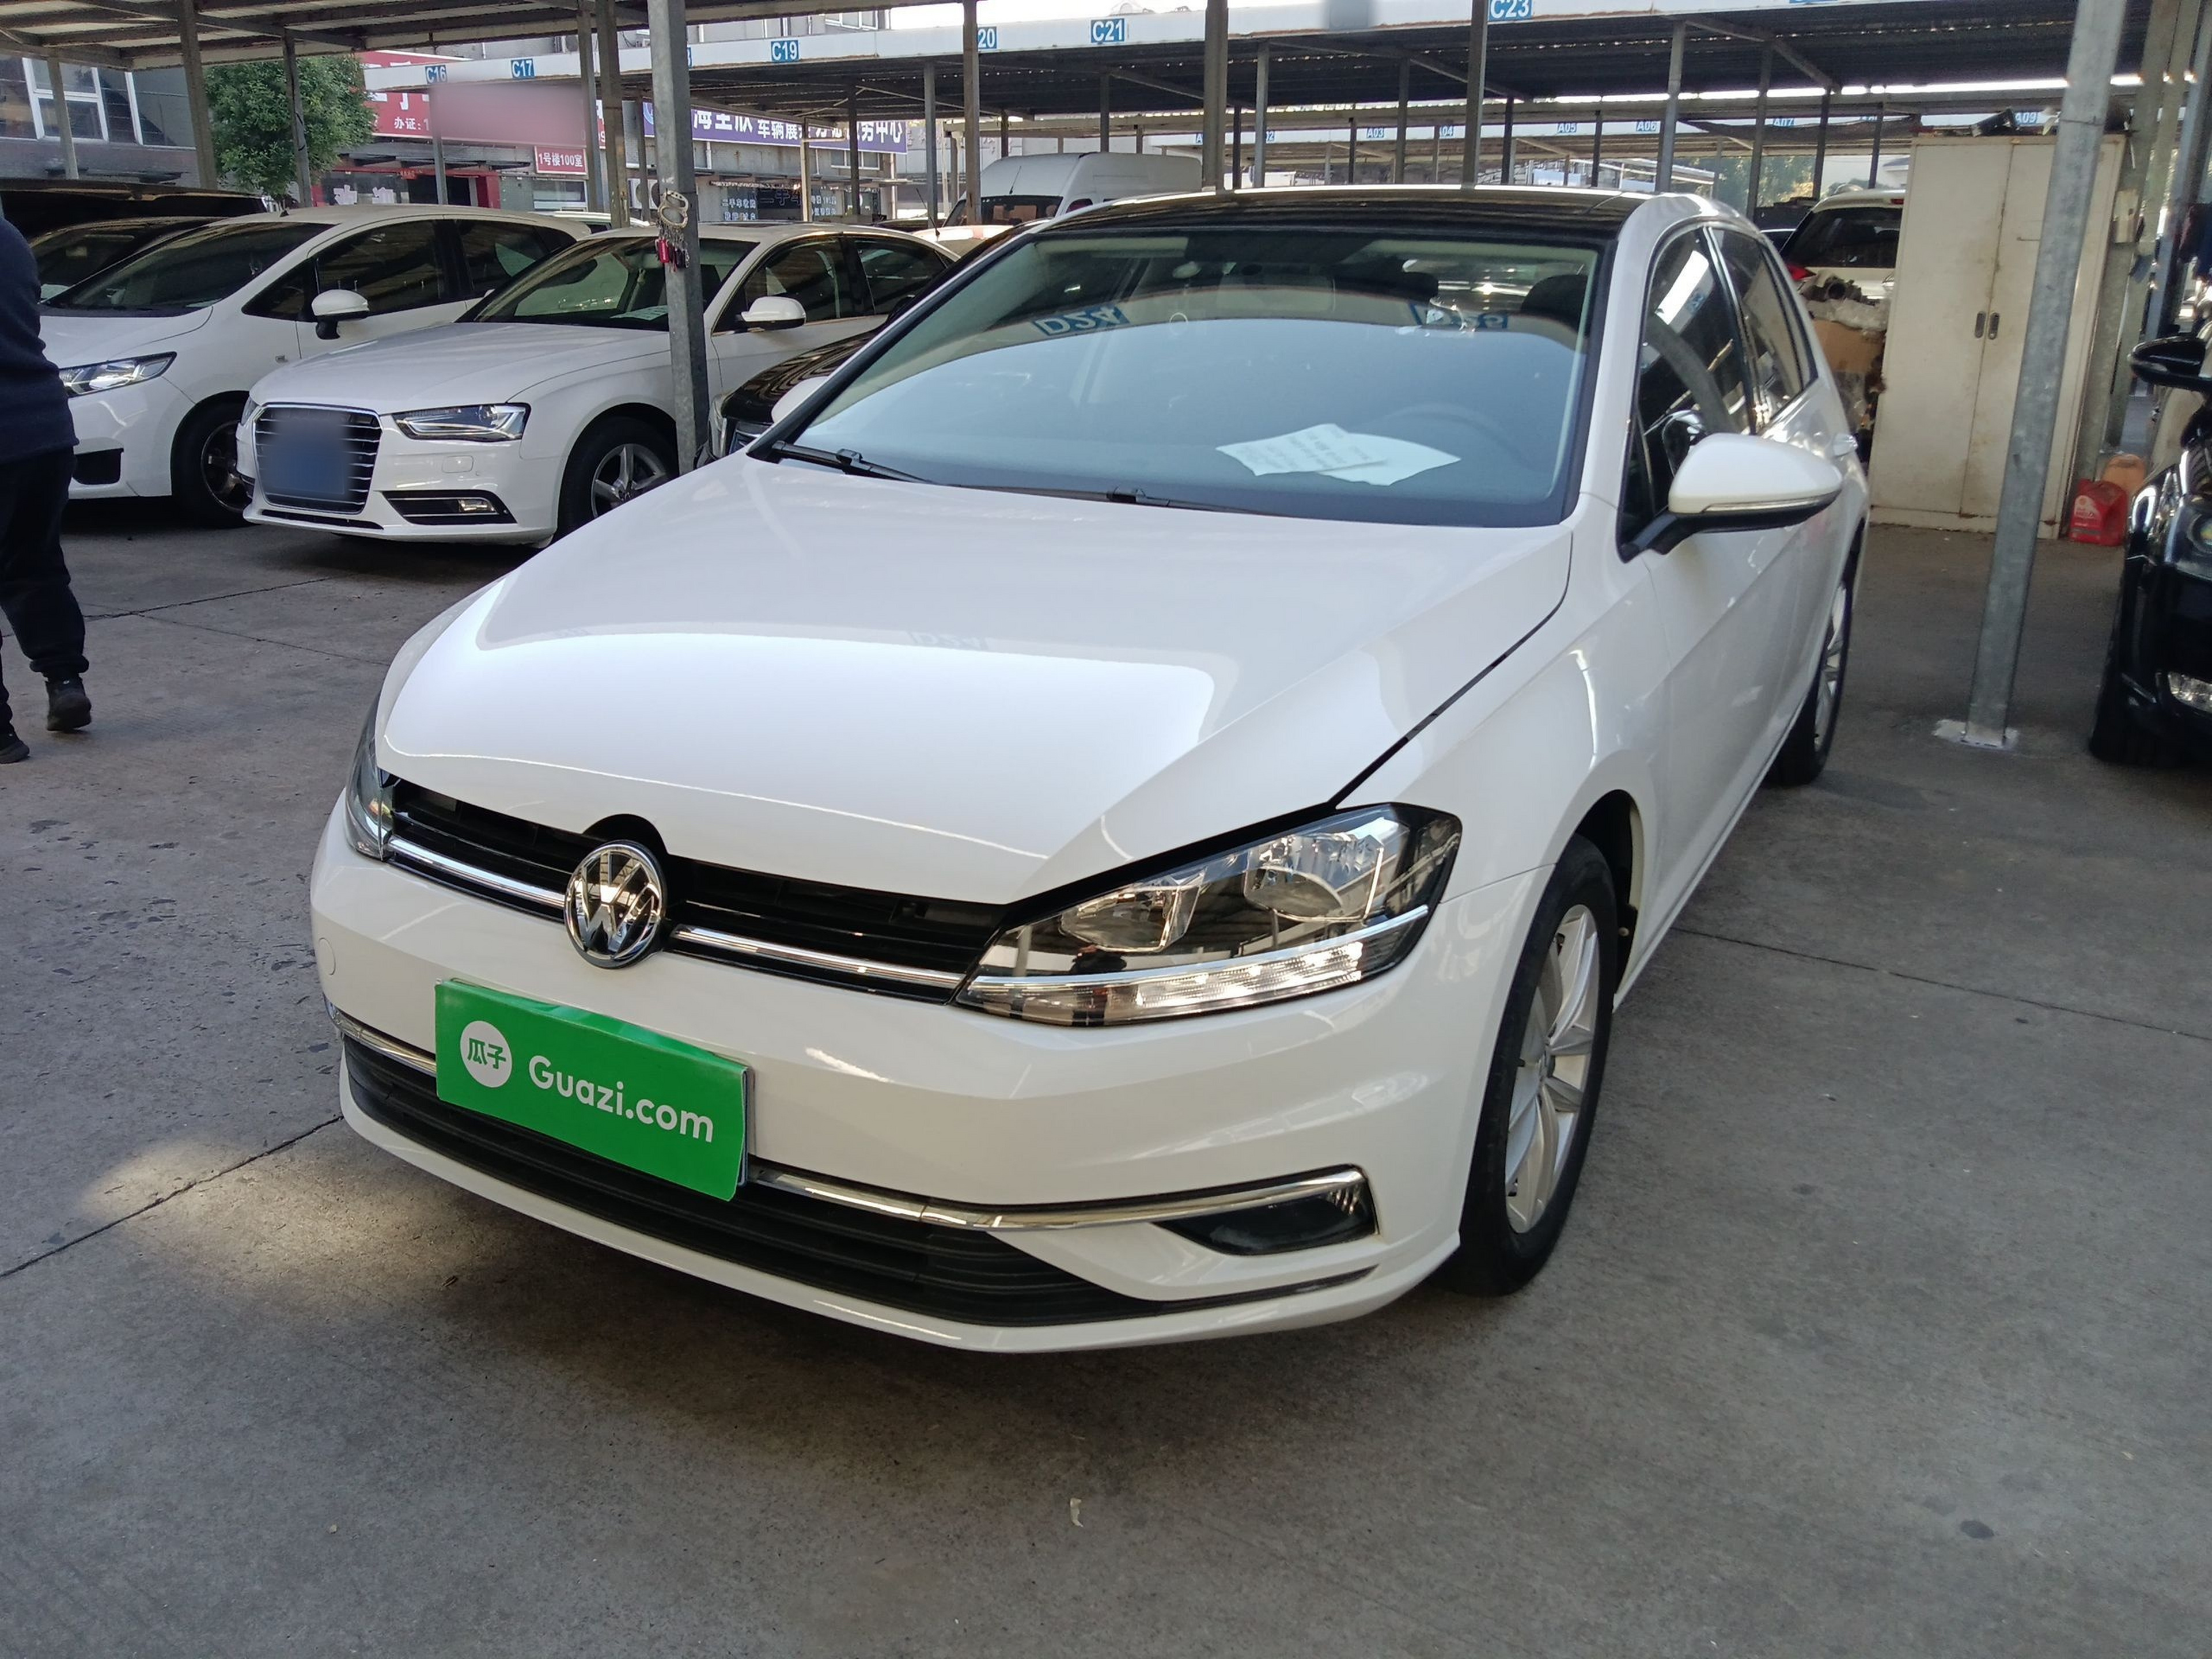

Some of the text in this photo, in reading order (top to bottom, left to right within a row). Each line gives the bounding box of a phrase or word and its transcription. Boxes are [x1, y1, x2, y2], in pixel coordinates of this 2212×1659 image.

[1490, 0, 1529, 18] C23
[978, 28, 996, 48] 20
[1092, 20, 1123, 41] C21
[772, 41, 798, 60] C19
[426, 66, 446, 84] C16
[512, 59, 532, 77] C17
[1367, 128, 1384, 138] A03
[1558, 123, 1576, 133] A05
[1637, 121, 1657, 131] A06
[539, 152, 583, 168] 1号楼100室
[467, 1037, 506, 1070] 瓜子
[528, 1055, 714, 1143] Guazi.com
